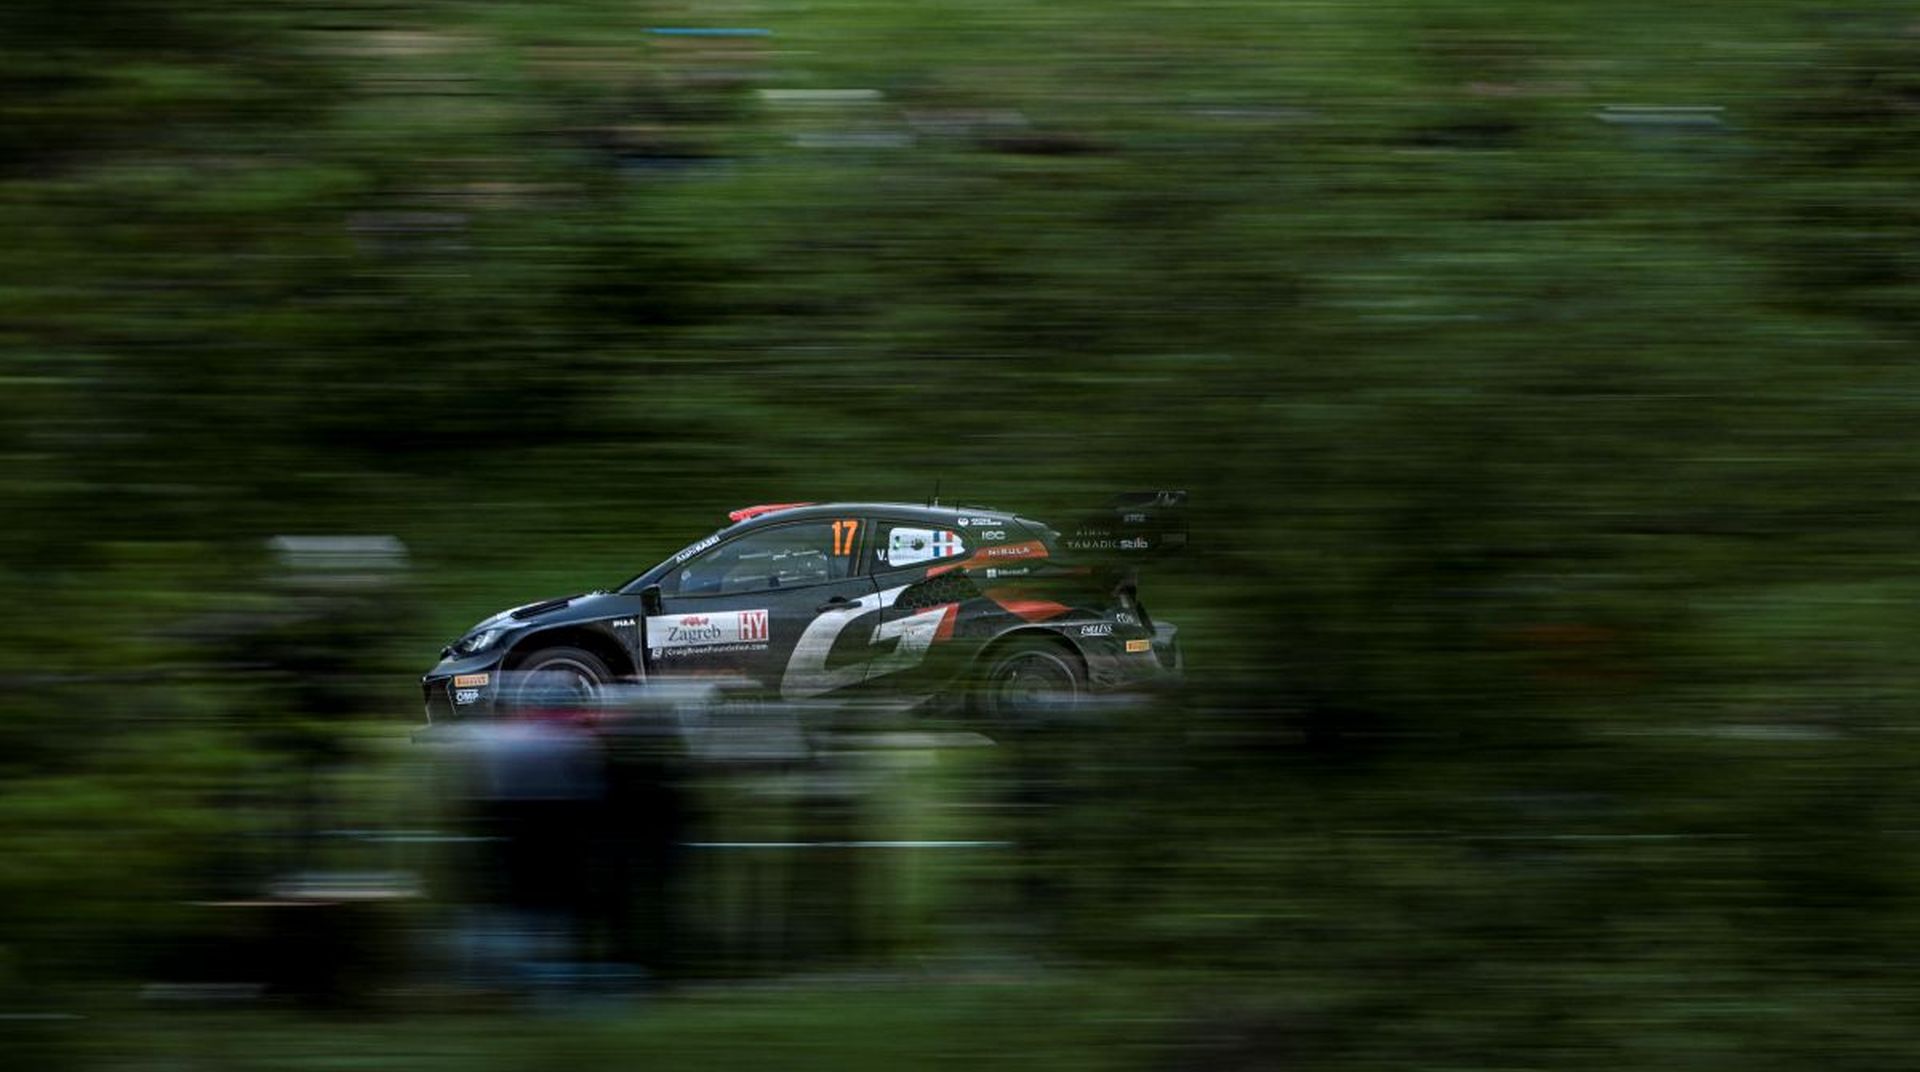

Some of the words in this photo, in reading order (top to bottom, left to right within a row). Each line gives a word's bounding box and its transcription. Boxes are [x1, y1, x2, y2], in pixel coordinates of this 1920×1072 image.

[832, 520, 858, 556] 17
[668, 624, 721, 643] Zagreb
[456, 692, 479, 702] OMP
